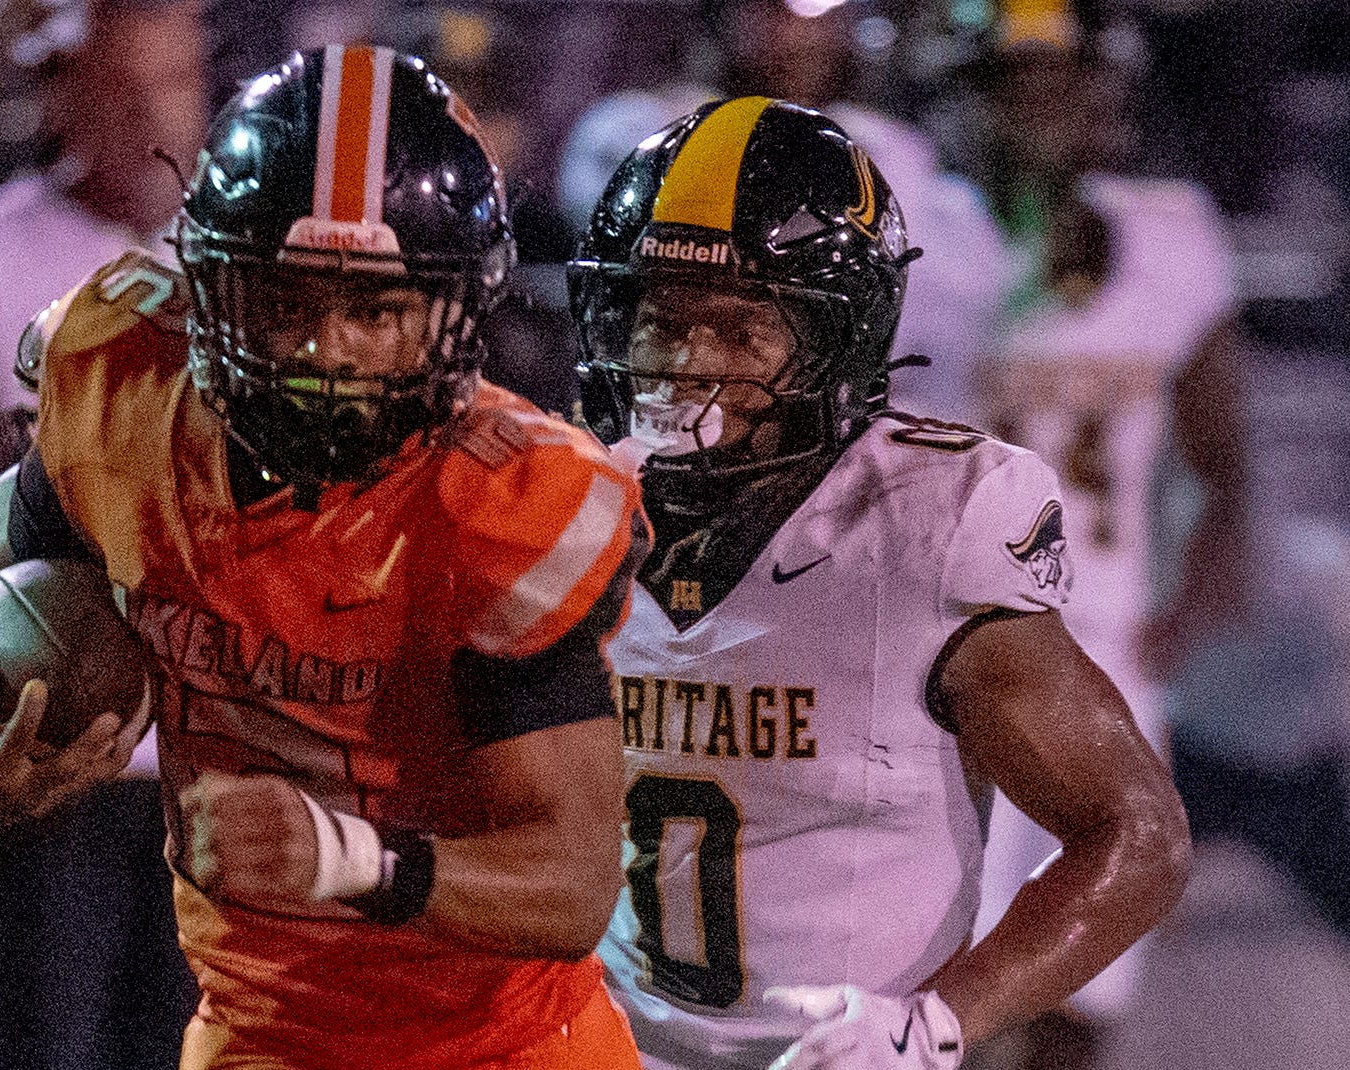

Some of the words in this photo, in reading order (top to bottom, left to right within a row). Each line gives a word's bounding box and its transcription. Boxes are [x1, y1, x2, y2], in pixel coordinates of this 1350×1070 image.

[639, 236, 729, 265] Riddell
[618, 675, 818, 762] RITAGE
[624, 770, 748, 1010] 0
